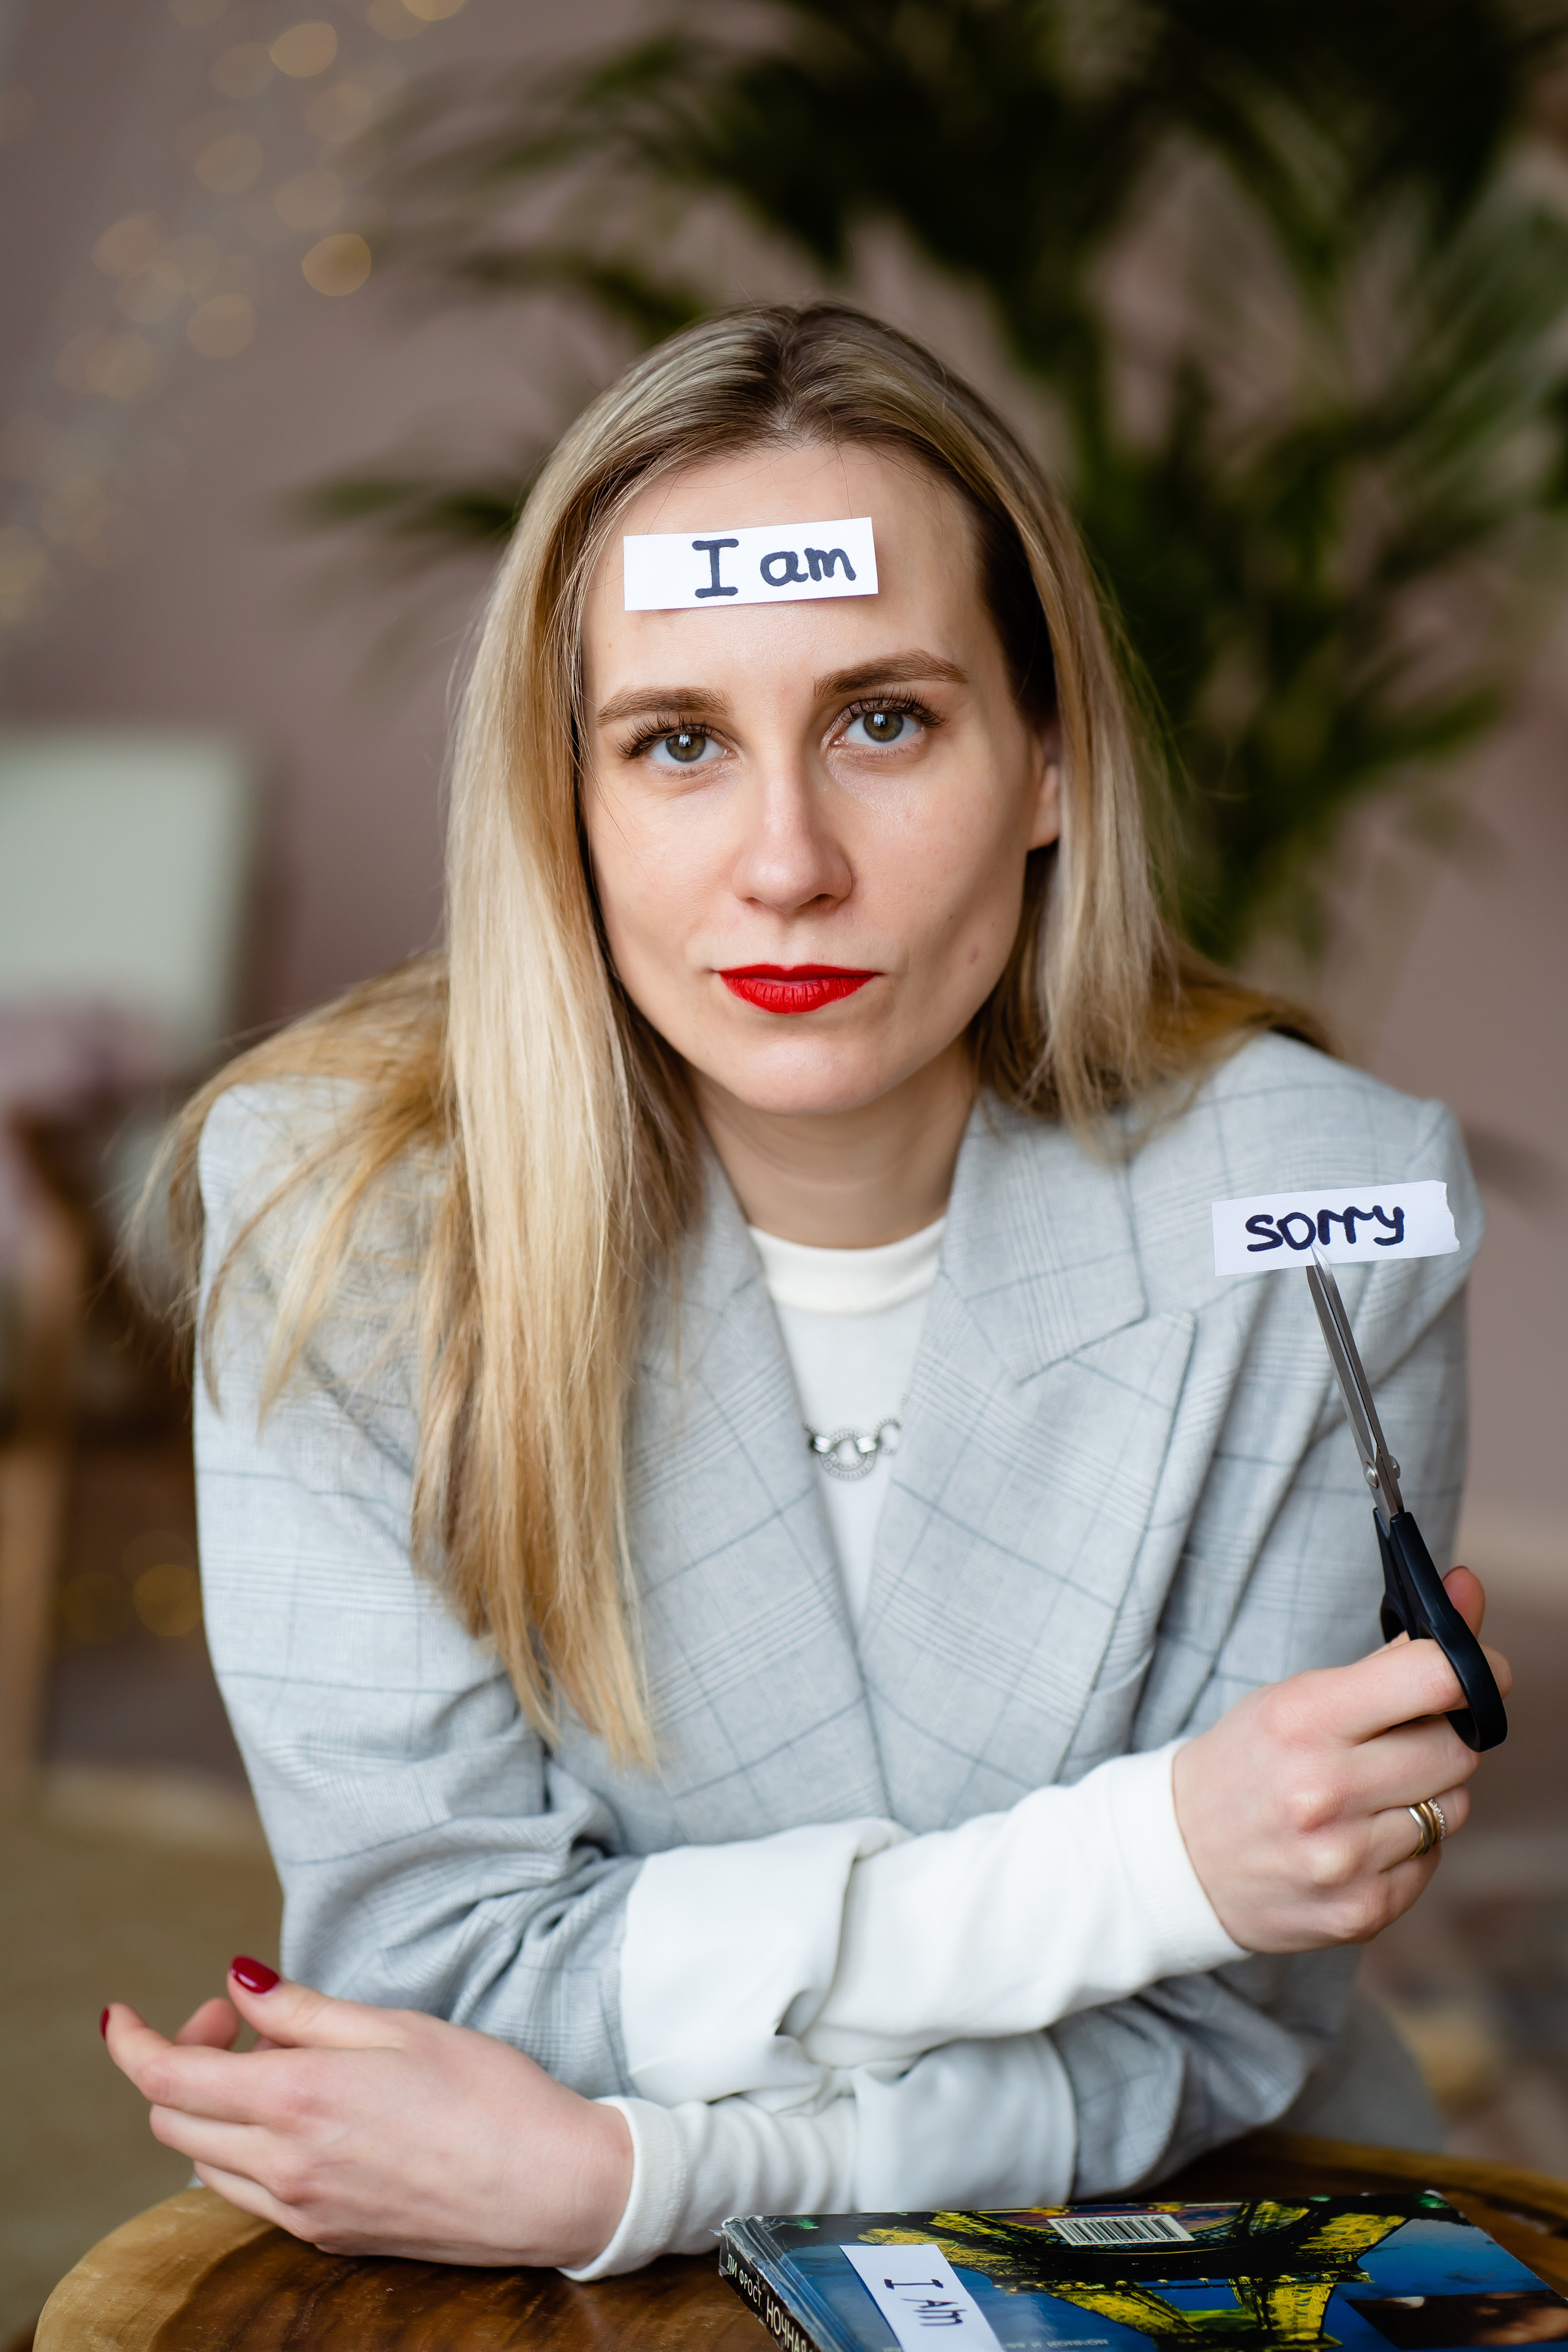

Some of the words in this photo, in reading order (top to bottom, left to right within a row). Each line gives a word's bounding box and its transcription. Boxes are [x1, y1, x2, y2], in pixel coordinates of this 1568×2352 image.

[692, 538, 739, 598] I
[760, 548, 857, 587] am
[1245, 1205, 1404, 1252] sorry
[727, 2253, 737, 2278] ЛИ
[739, 2269, 762, 2307] ФРОСТ
[884, 2278, 944, 2290] I
